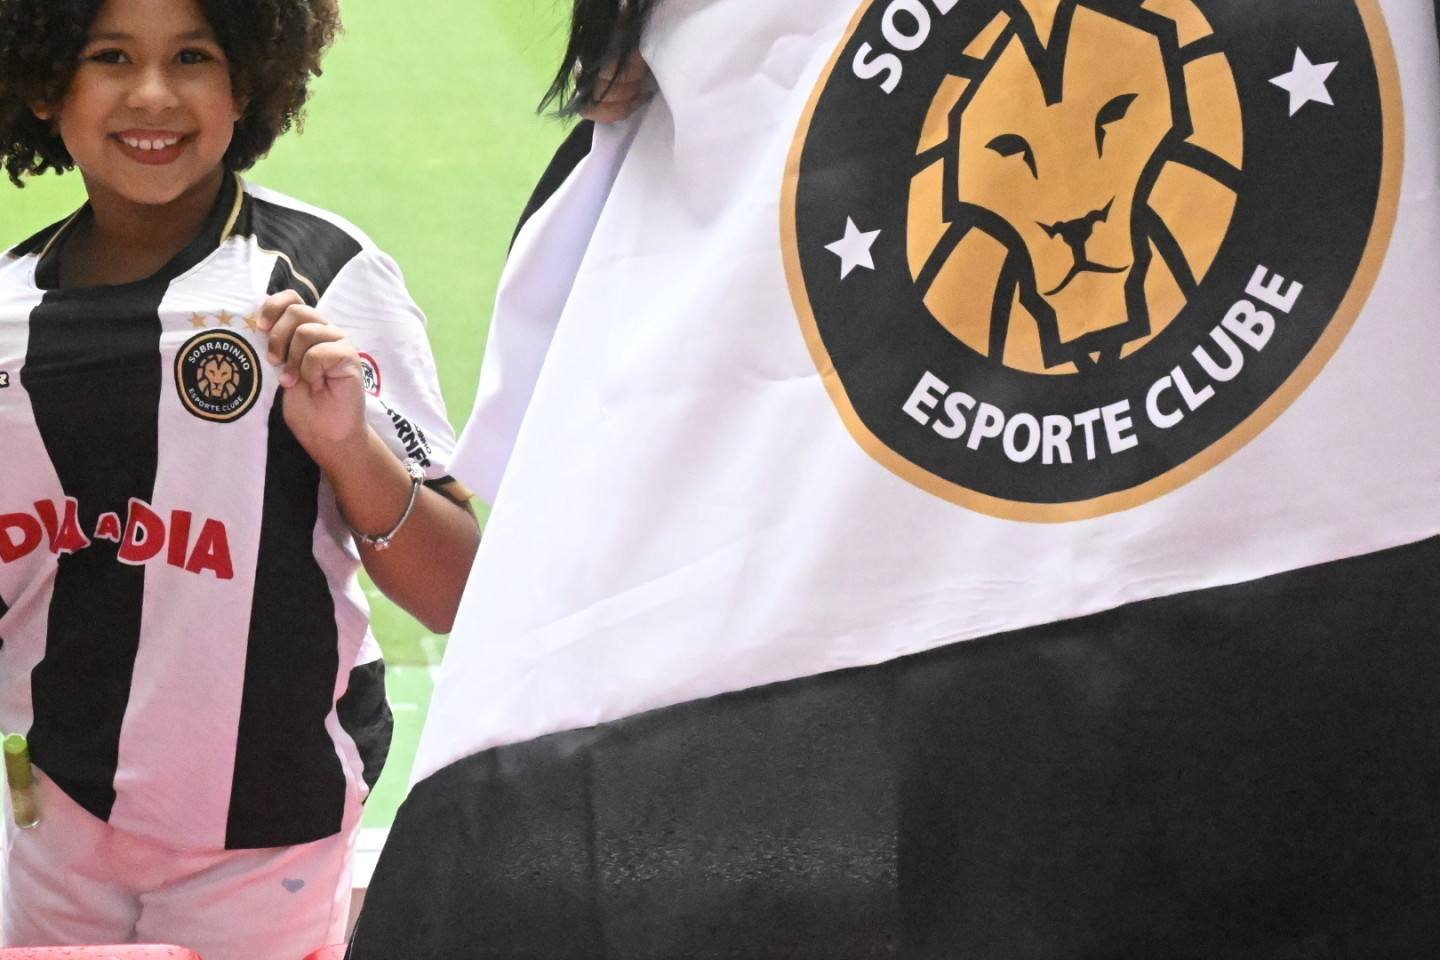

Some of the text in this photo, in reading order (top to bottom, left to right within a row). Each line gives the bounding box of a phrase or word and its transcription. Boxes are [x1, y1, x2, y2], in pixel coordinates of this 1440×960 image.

[187, 341, 250, 371] SOBRADINHO
[901, 263, 1304, 465] ESPORTE CLUBE
[188, 387, 221, 412] ESPORTE
[93, 511, 122, 543] A
[116, 496, 234, 581] DIA
